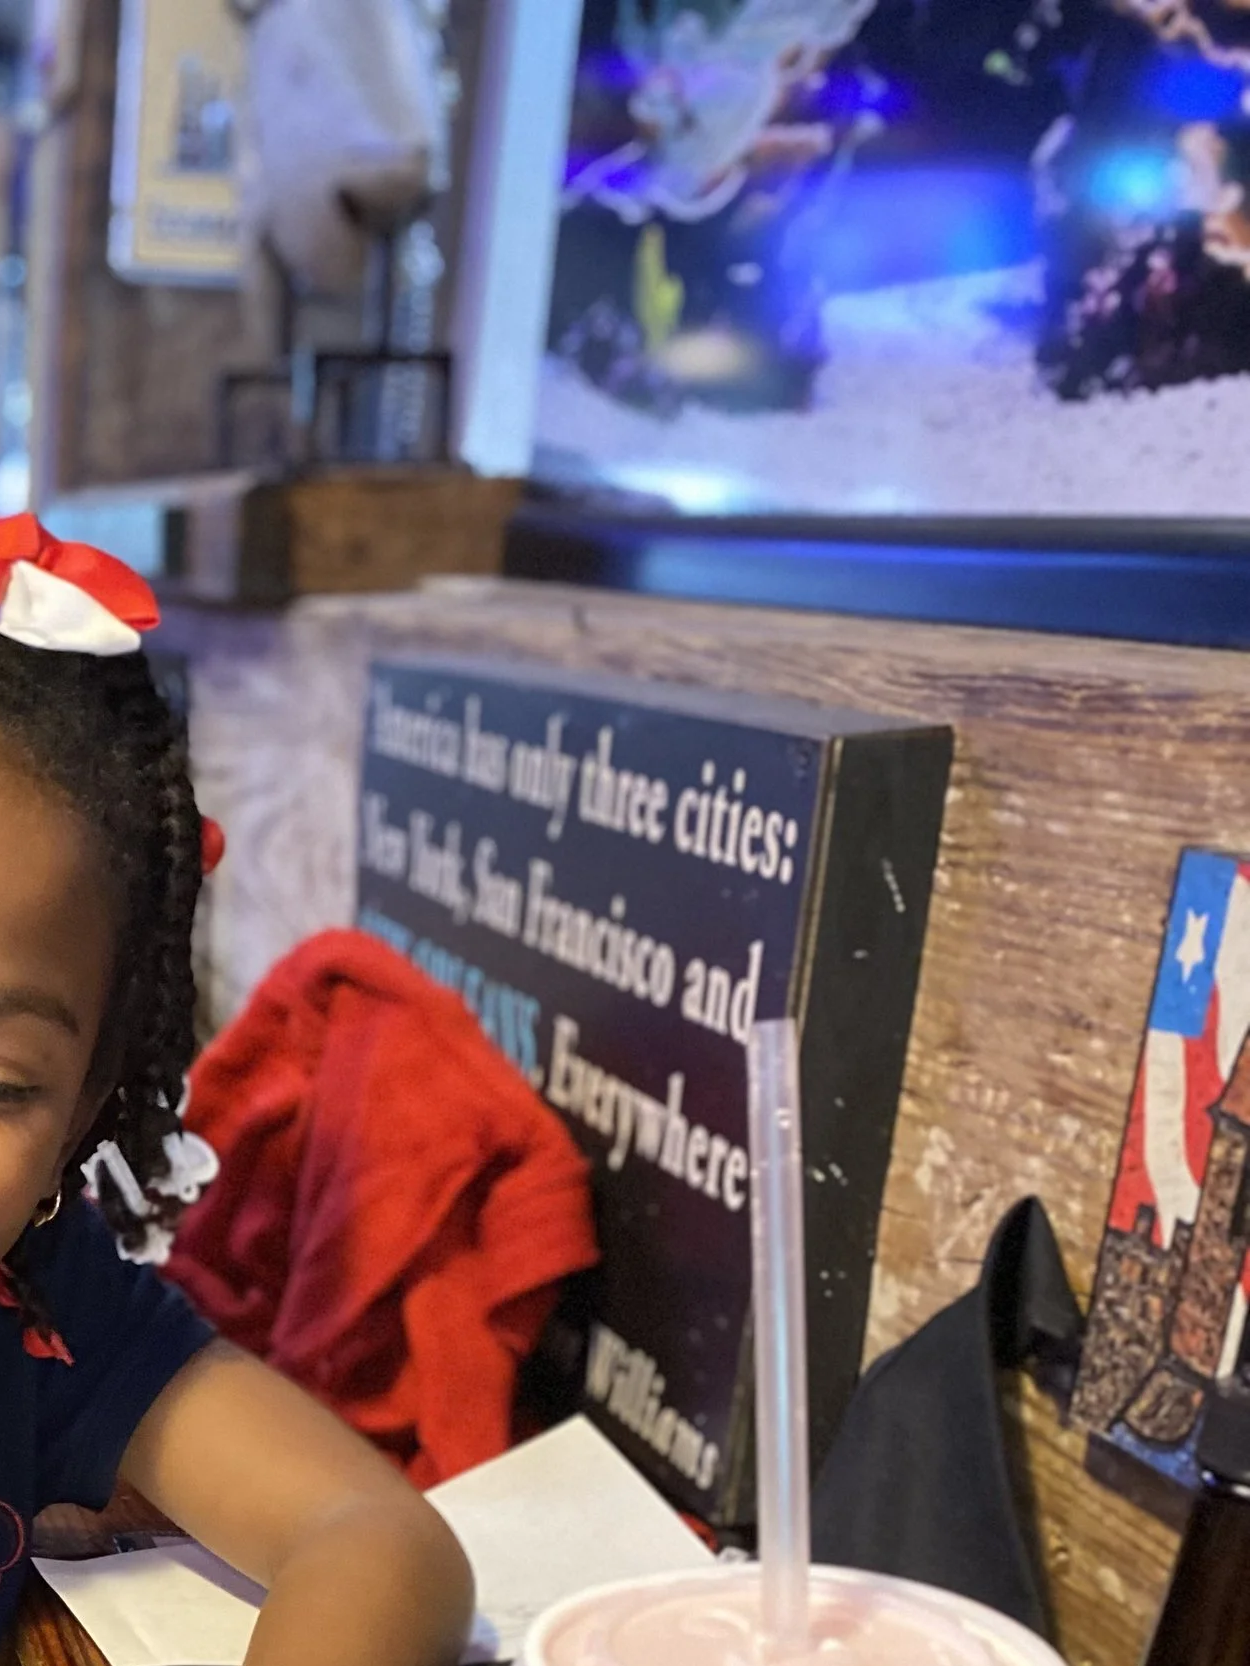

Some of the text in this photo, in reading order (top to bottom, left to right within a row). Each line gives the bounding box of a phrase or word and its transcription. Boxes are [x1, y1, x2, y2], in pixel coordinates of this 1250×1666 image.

[463, 693, 508, 793] has
[509, 714, 578, 841] only
[579, 726, 669, 843] three
[674, 761, 798, 884] cities:
[472, 836, 523, 940] San
[522, 857, 677, 1008] Francisco
[681, 940, 764, 1045] and
[546, 1014, 749, 1212] Everywhere
